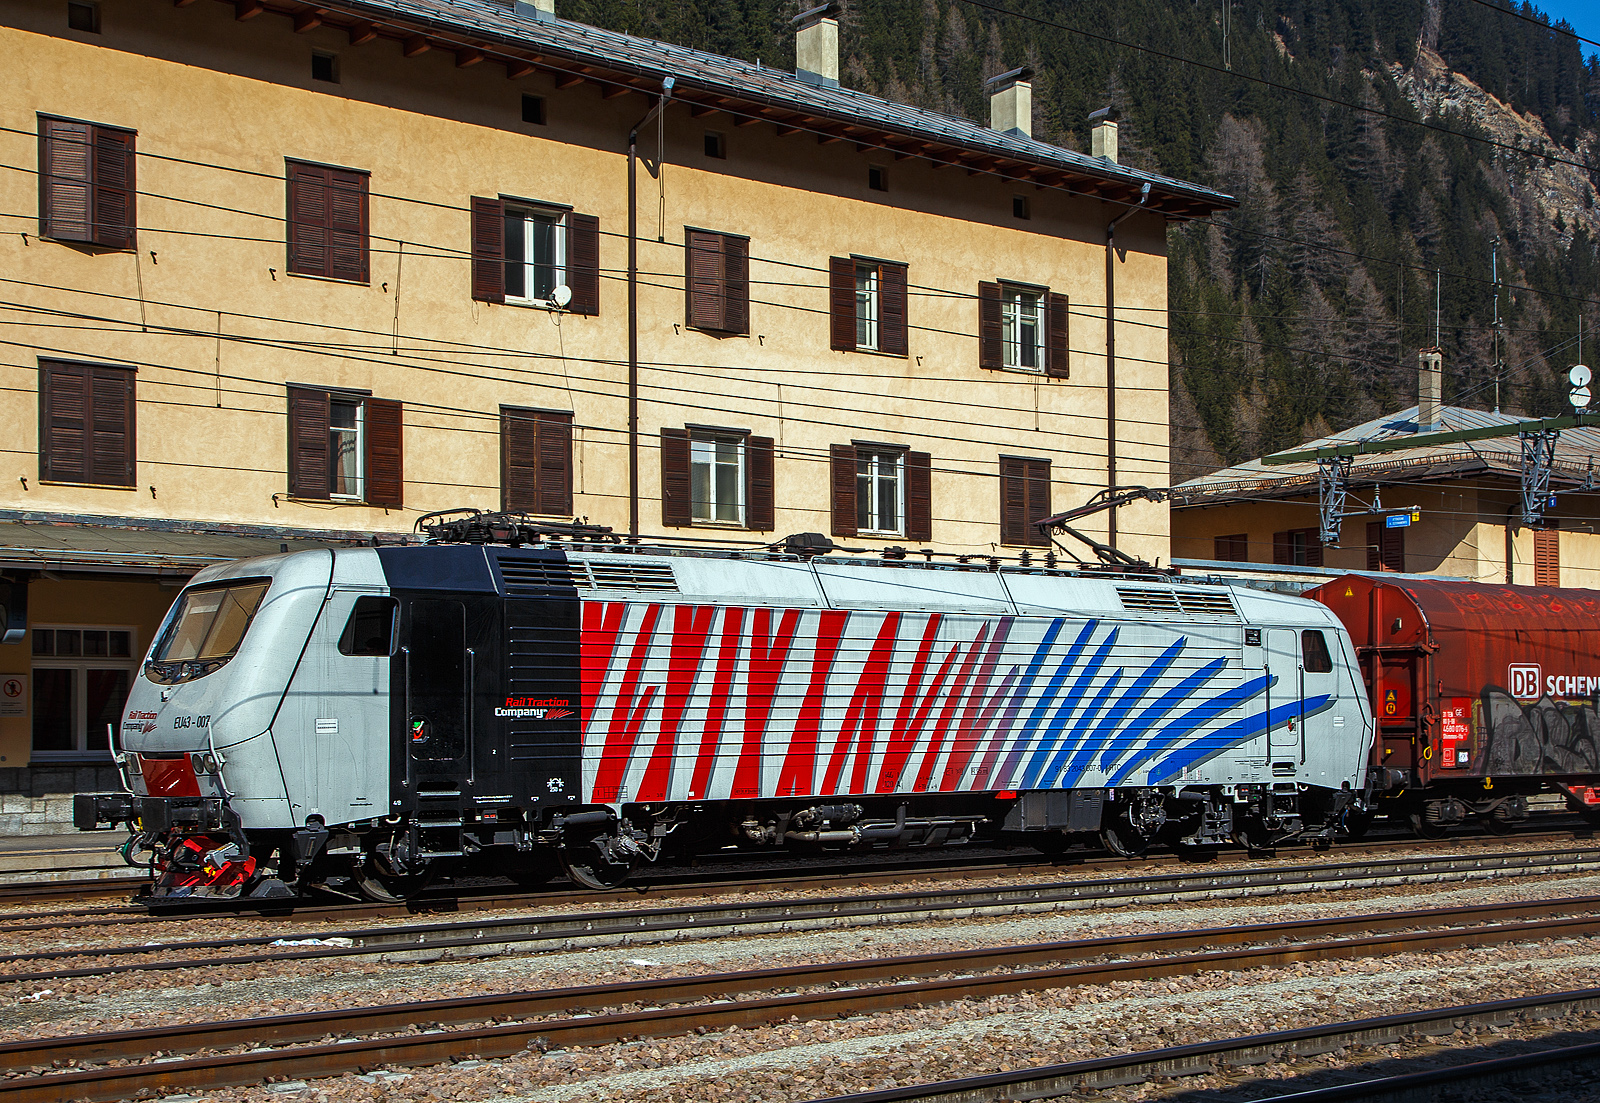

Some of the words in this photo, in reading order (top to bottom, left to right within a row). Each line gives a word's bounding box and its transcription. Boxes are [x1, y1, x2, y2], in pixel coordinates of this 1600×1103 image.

[1513, 670, 1537, 696] DB
[1546, 675, 1600, 697] SCHEN
[505, 697, 526, 707] Rail
[527, 697, 570, 707] Traction
[128, 710, 137, 720] Rail
[137, 710, 158, 720] Traction
[494, 707, 544, 719] Company
[122, 721, 144, 732] Company
[173, 715, 192, 729] EU43
[196, 715, 211, 728] 007
